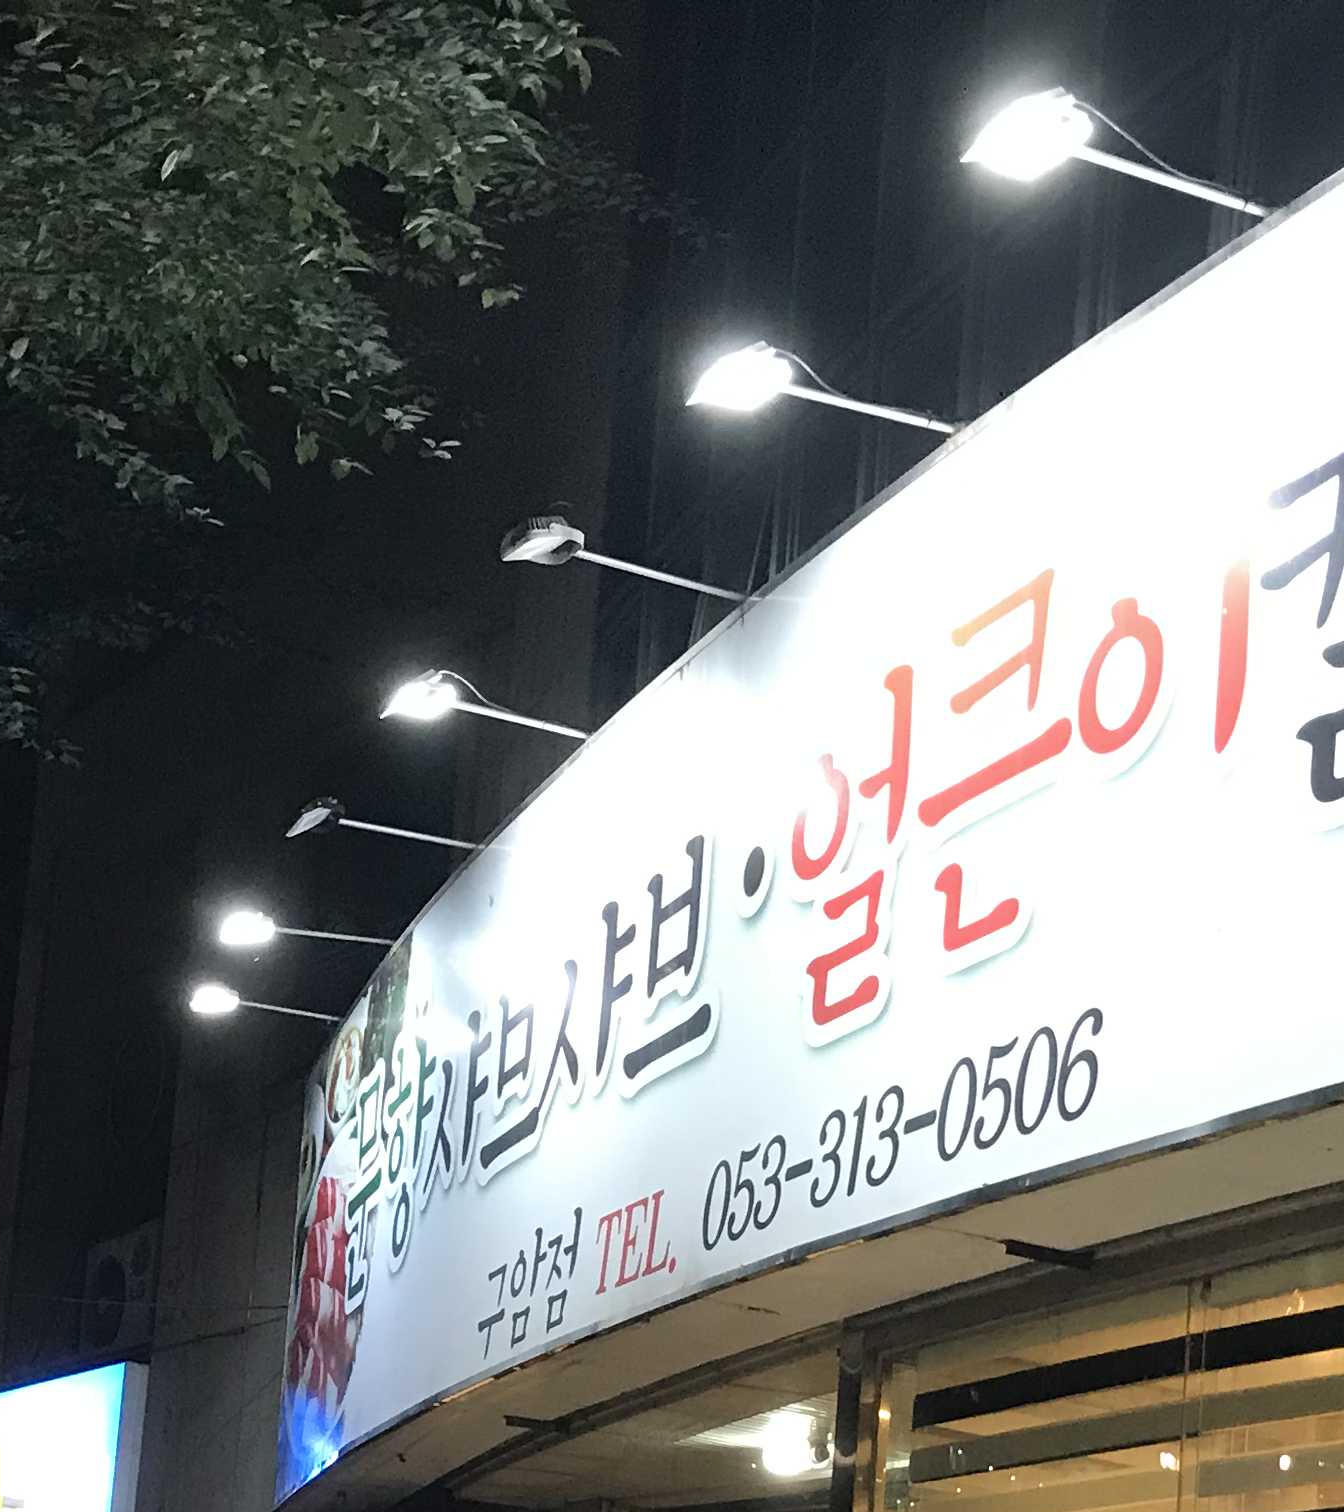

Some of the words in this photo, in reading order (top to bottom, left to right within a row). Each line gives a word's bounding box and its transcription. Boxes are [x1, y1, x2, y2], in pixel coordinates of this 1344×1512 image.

[477, 1206, 583, 1361] 구암점
[595, 1189, 678, 1296] TEL.
[702, 1004, 1102, 1252] 053-313-0506
